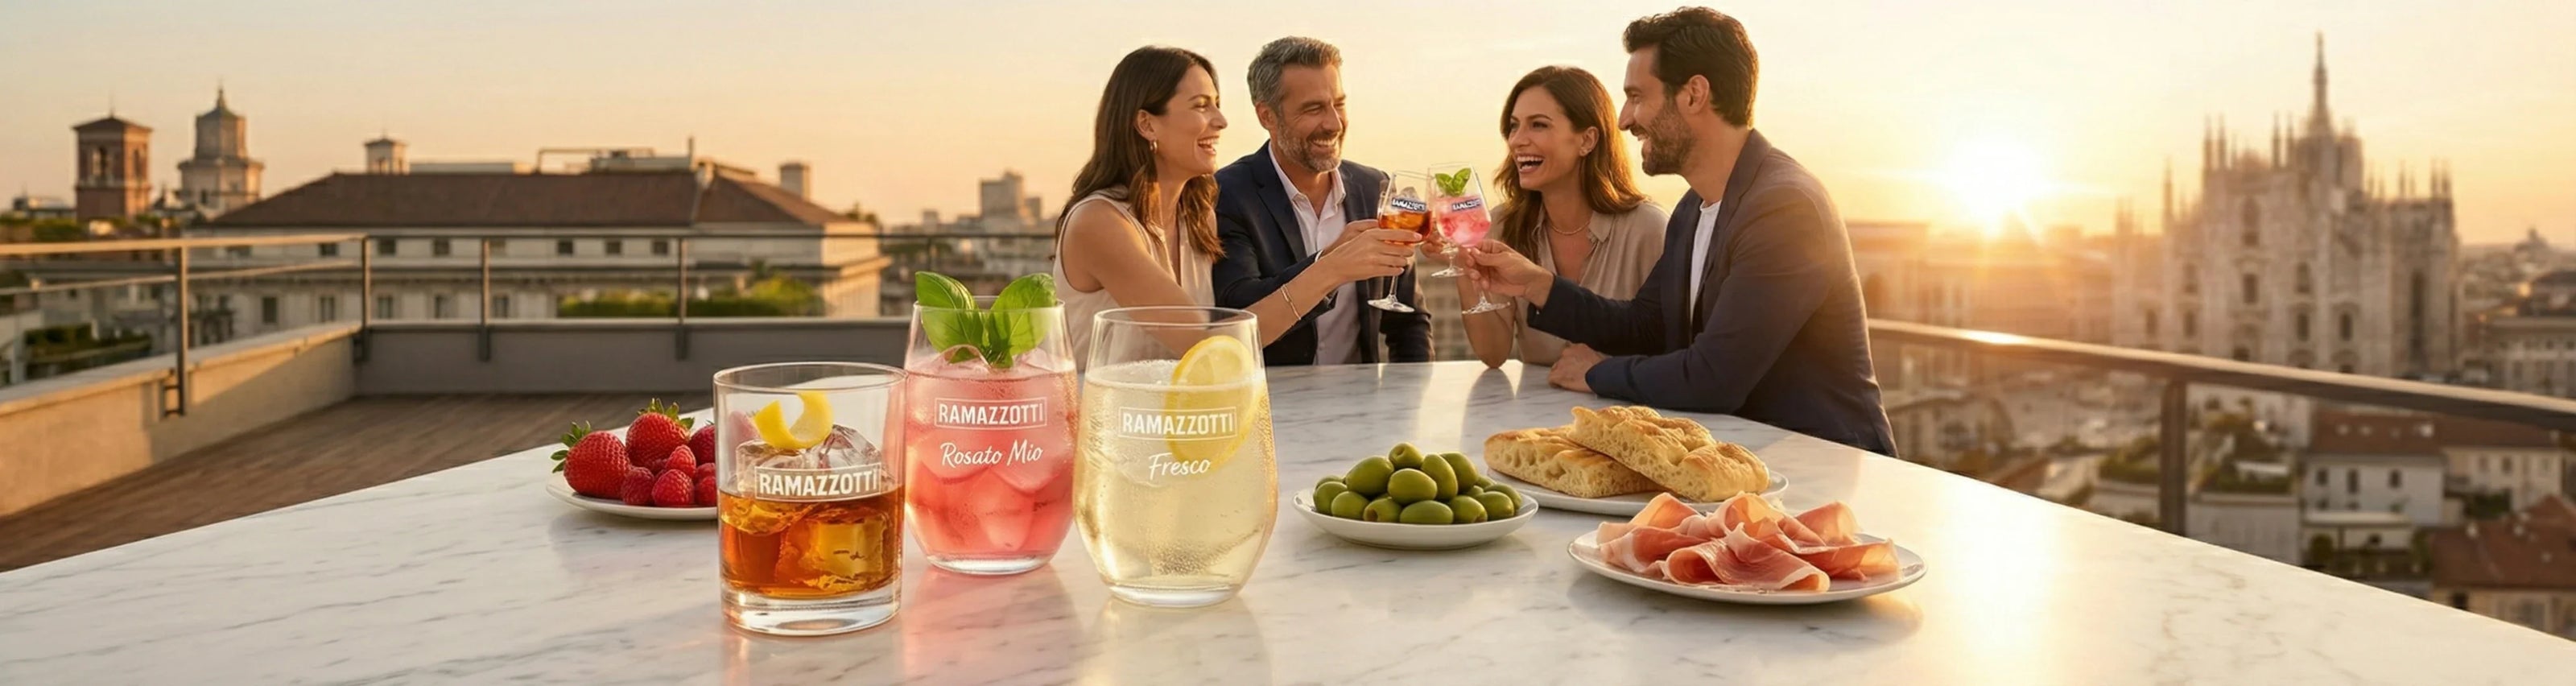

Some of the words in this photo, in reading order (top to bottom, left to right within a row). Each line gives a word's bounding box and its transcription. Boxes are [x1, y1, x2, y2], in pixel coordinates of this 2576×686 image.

[938, 403, 1044, 425] RAMAZZOTTI
[1122, 412, 1233, 435] RAMAZZOTTI
[940, 443, 1003, 469] Rosato
[1006, 439, 1044, 466] Mio
[1148, 452, 1211, 481] Fresco
[759, 470, 877, 497] RAMAZZOTTI
